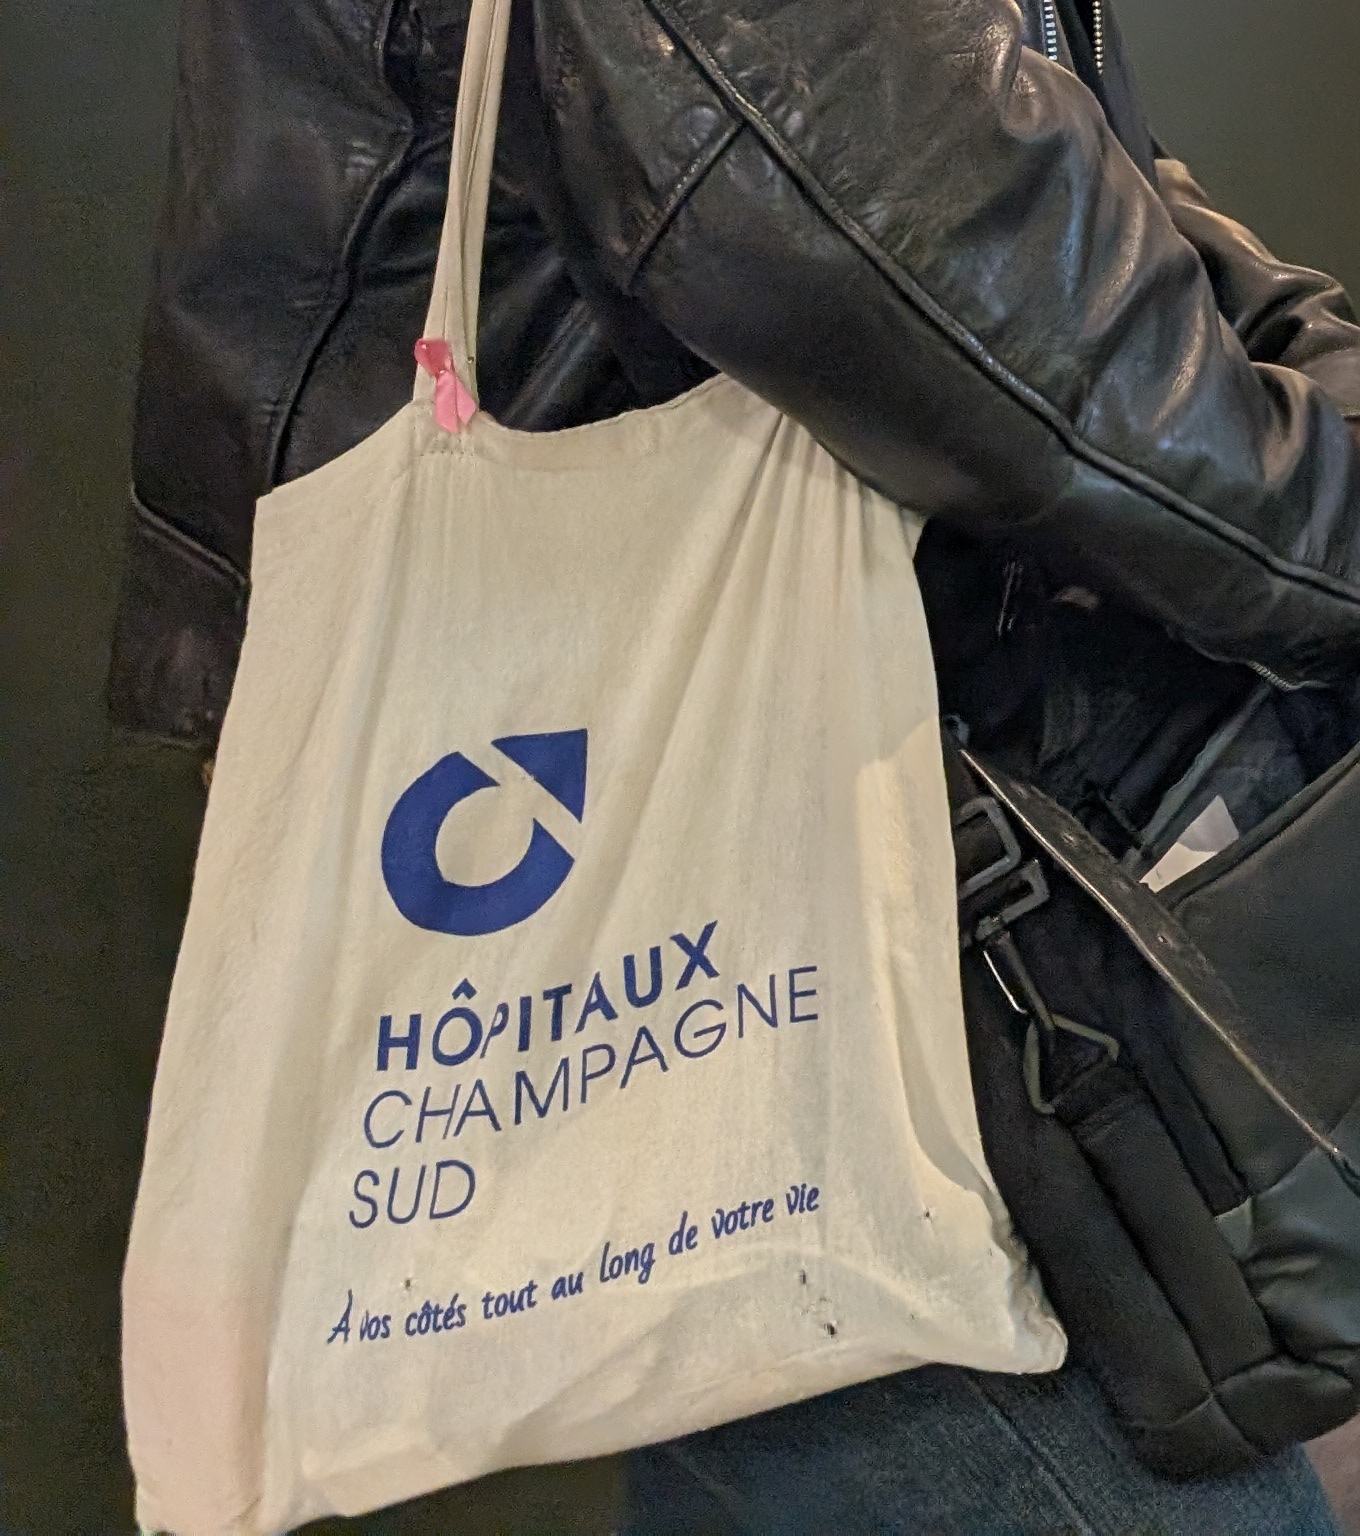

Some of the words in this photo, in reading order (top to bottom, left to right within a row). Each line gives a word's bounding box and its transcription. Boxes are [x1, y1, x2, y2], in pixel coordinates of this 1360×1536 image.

[363, 966, 819, 1150] CHAMPAGNE
[376, 920, 720, 1072] HÔPITAUX
[349, 1159, 476, 1229] SUD
[360, 1309, 392, 1342] vos
[404, 1293, 467, 1337] côtés
[482, 1279, 538, 1321] tout
[551, 1271, 584, 1301] au
[599, 1241, 656, 1284] long
[669, 1210, 698, 1256] de
[711, 1198, 775, 1240] votre
[786, 1183, 820, 1216] vie
